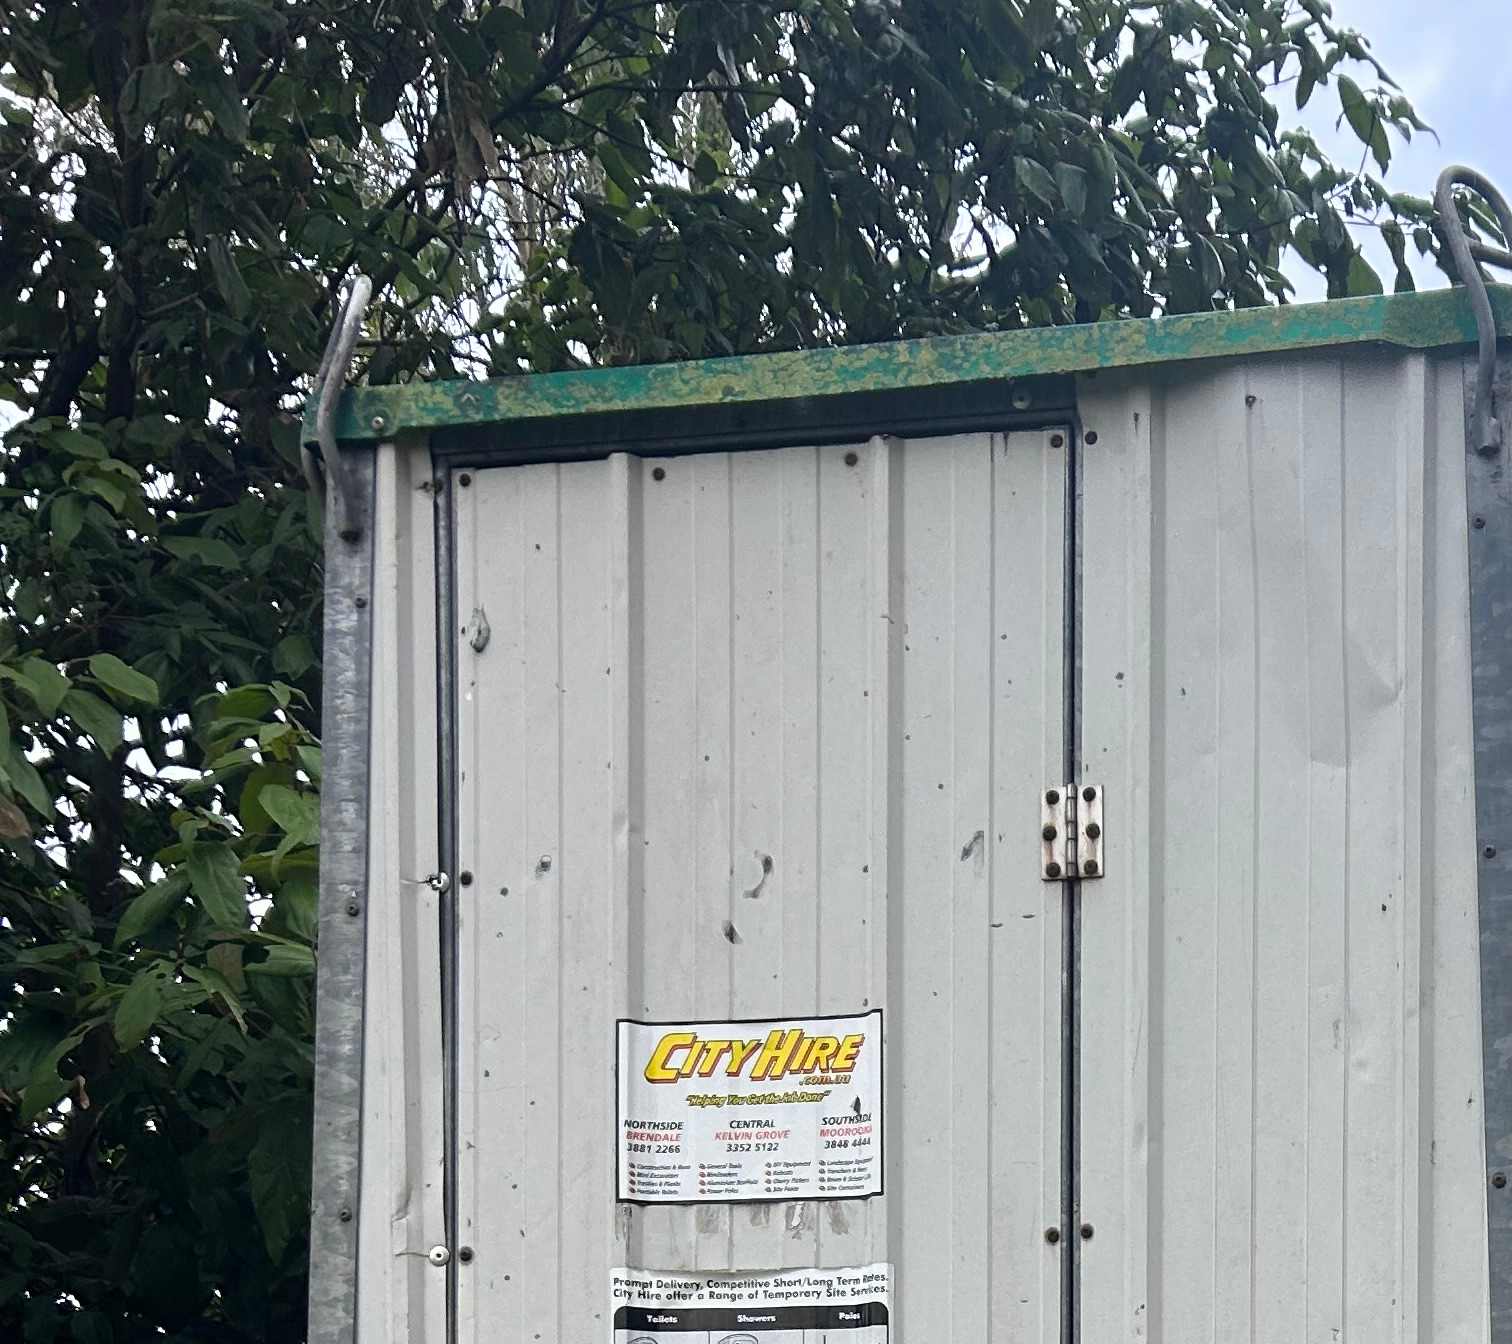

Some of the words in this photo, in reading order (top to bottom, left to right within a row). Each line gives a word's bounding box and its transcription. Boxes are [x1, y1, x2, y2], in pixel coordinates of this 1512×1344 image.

[623, 1119, 684, 1130] NORTHSIDE
[729, 1119, 776, 1129] CENTRAL
[626, 1131, 682, 1141] BRENDALE
[715, 1131, 752, 1141] KELVIN
[756, 1130, 790, 1140] GROVE
[627, 1143, 652, 1153] 3881
[656, 1144, 681, 1154] 2266
[726, 1143, 752, 1153] 3352
[613, 1277, 653, 1290] Prompt
[656, 1280, 703, 1291] Delivery,
[706, 1278, 770, 1291] Competitive
[773, 1276, 833, 1290] Short/Long
[836, 1276, 861, 1286] Term
[613, 1288, 634, 1299] City
[638, 1290, 661, 1300] Hire
[666, 1290, 693, 1301] offer
[709, 1290, 744, 1302] Range
[747, 1290, 758, 1300] of
[763, 1289, 822, 1301] Temporary
[826, 1287, 847, 1298] Site
[646, 1314, 678, 1323] Toilets
[737, 1314, 776, 1323] Showers
